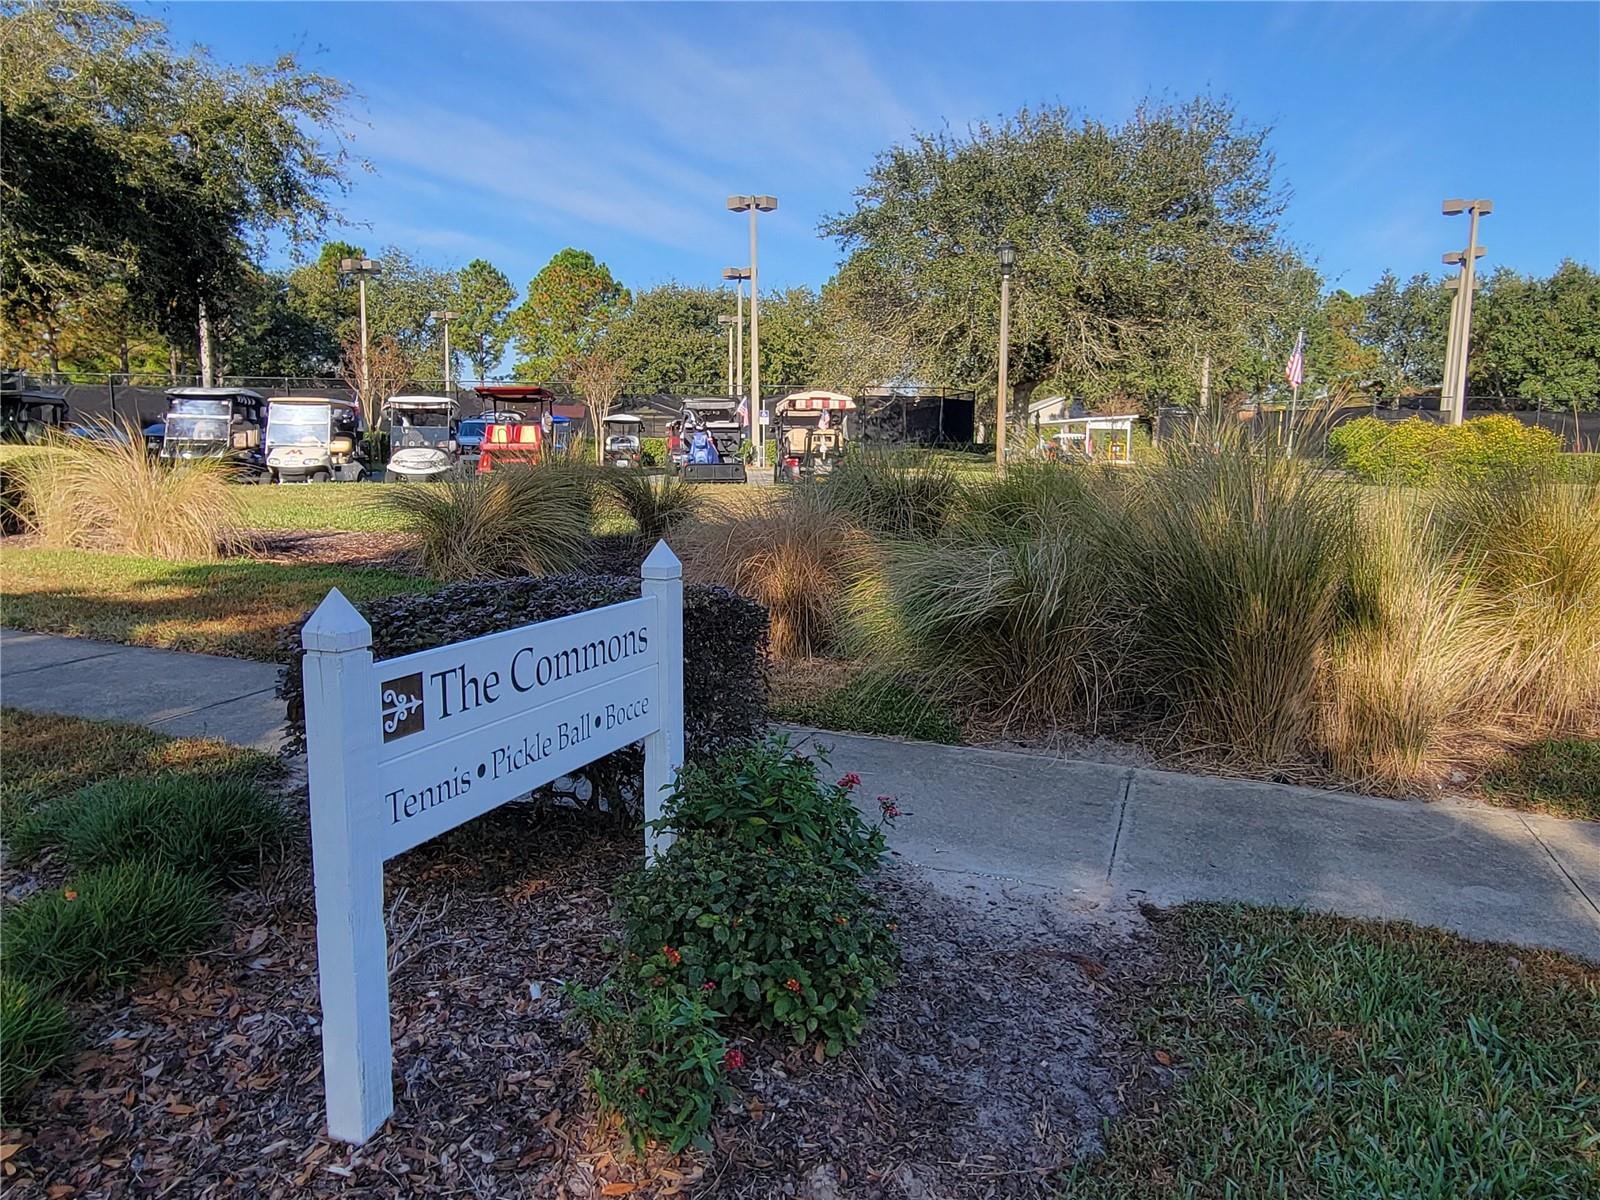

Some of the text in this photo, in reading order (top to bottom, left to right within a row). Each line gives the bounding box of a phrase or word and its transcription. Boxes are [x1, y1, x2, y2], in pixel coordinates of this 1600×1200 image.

[430, 626, 648, 720] The Commons
[385, 697, 649, 825] Tennis Pickle Ball Bocce
